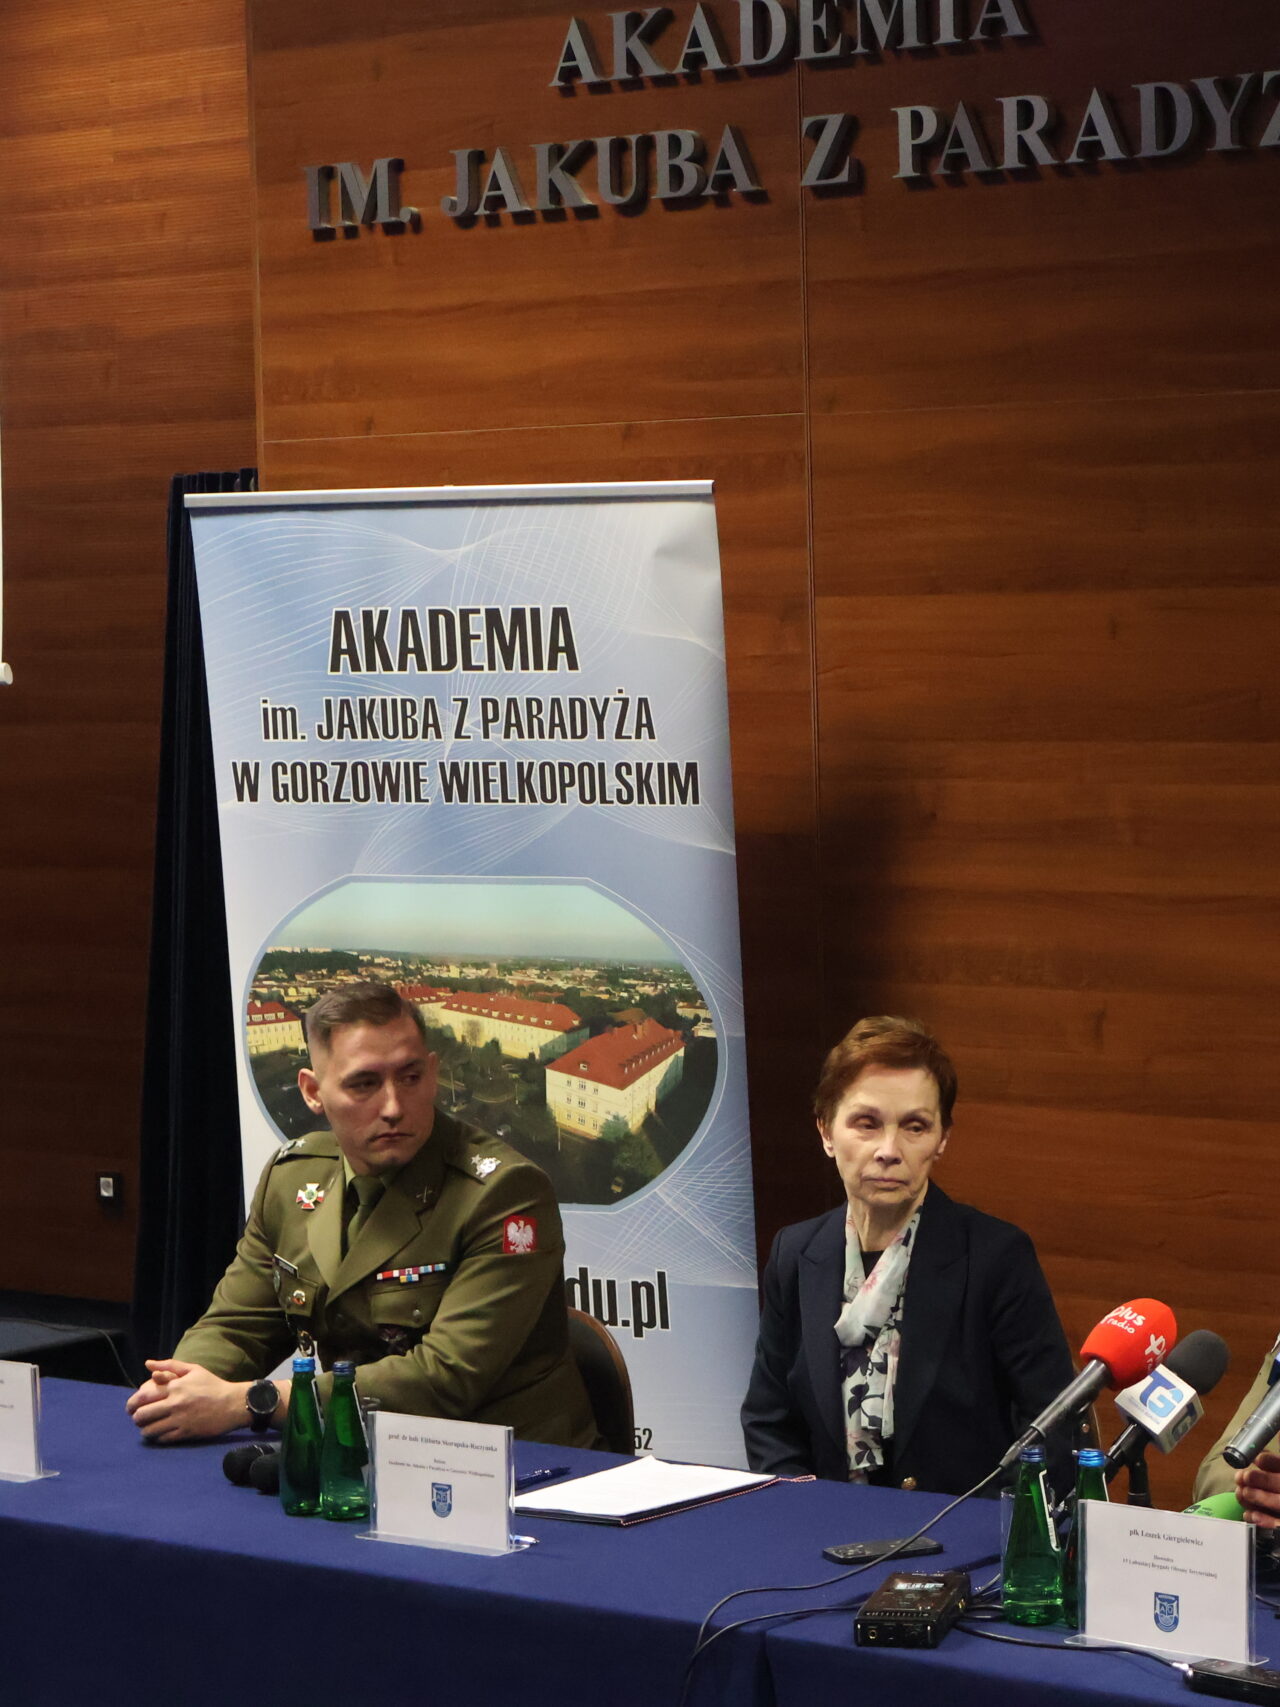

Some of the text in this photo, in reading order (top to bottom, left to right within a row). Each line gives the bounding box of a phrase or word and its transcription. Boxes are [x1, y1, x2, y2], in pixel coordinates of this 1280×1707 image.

[548, 0, 1030, 88] AKADEMIA
[304, 158, 414, 231] IM.
[441, 124, 763, 218] JAKUBA
[800, 113, 854, 188] Z
[329, 606, 580, 674] AKADEMIA
[261, 688, 656, 741] im. JAKUBA Z PARADYŻA
[232, 760, 701, 806] W GORZOWIE WIELKOPOLSKIM
[1107, 1317, 1135, 1334] radio
